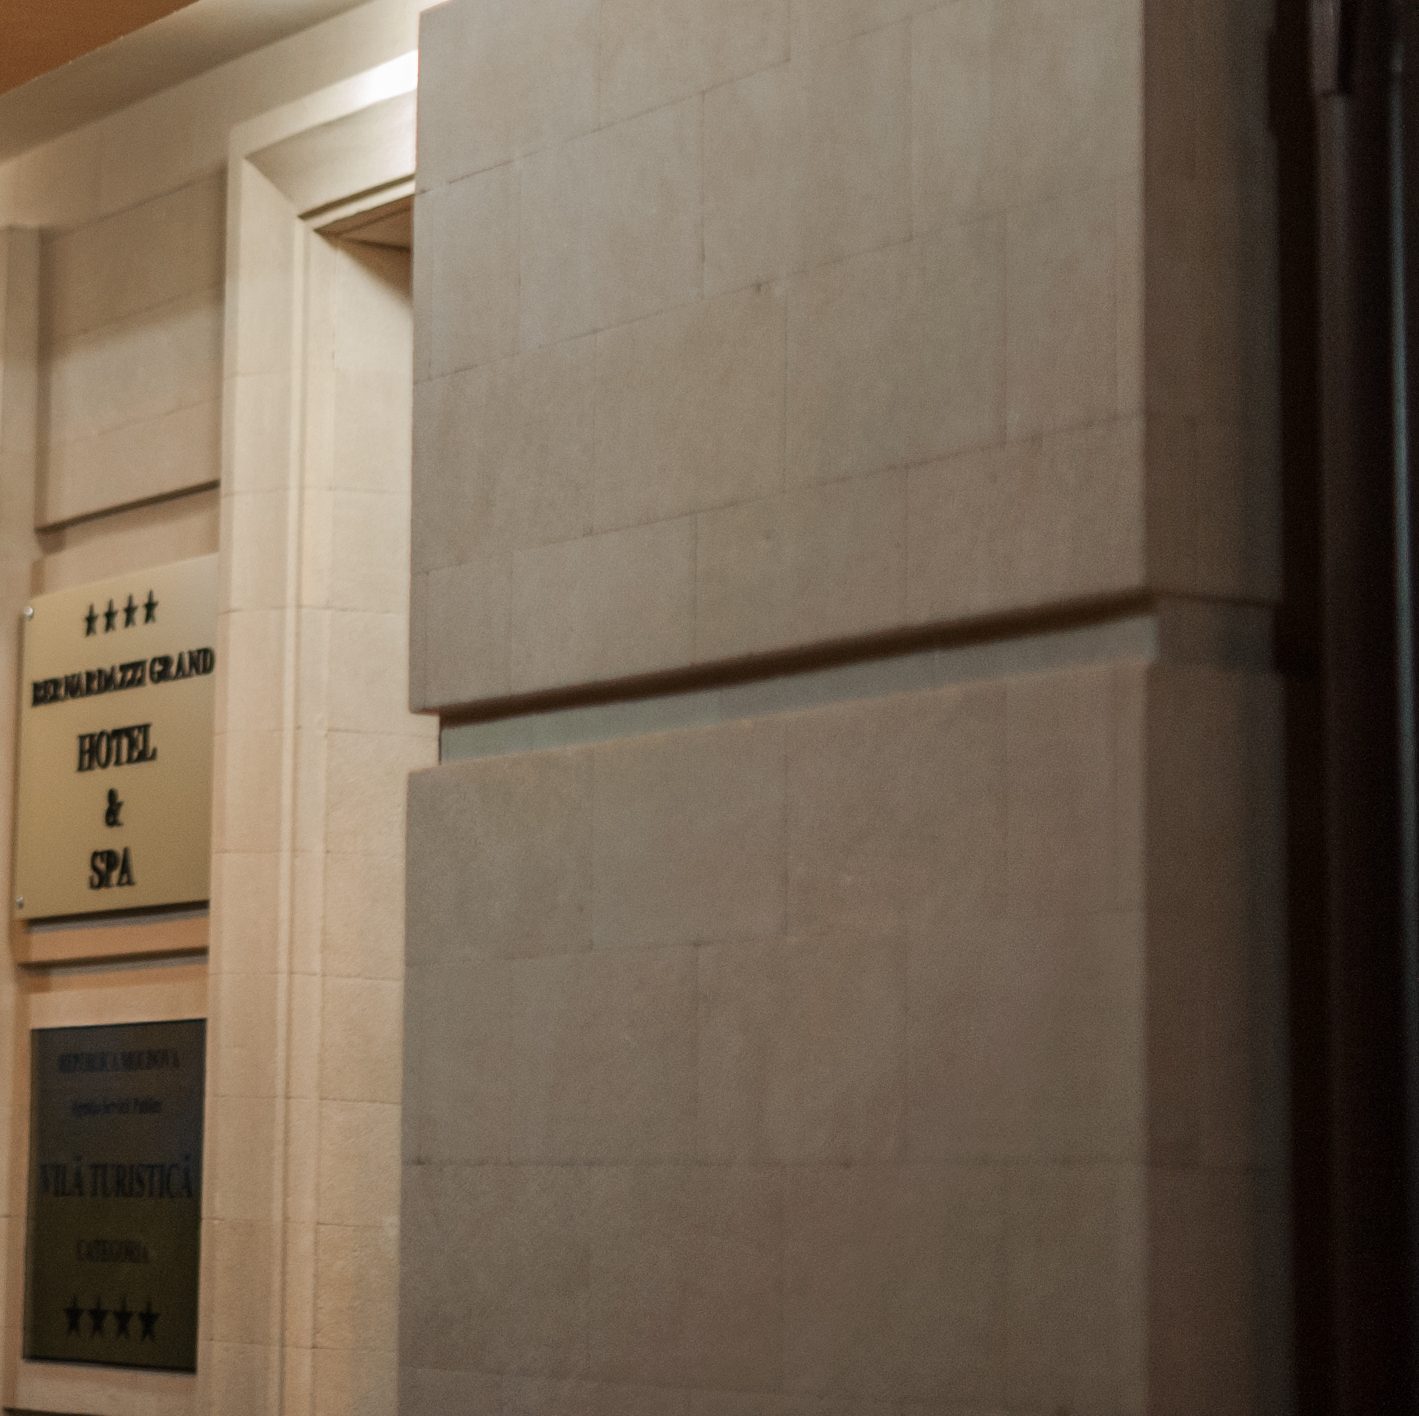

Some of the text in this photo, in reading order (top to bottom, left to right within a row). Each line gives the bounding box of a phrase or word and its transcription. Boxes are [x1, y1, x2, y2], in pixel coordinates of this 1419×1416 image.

[31, 647, 215, 708] BERNARDAZZI GRAND
[77, 723, 157, 773] HOTEL
[104, 788, 123, 827] &
[89, 846, 136, 890] SPA
